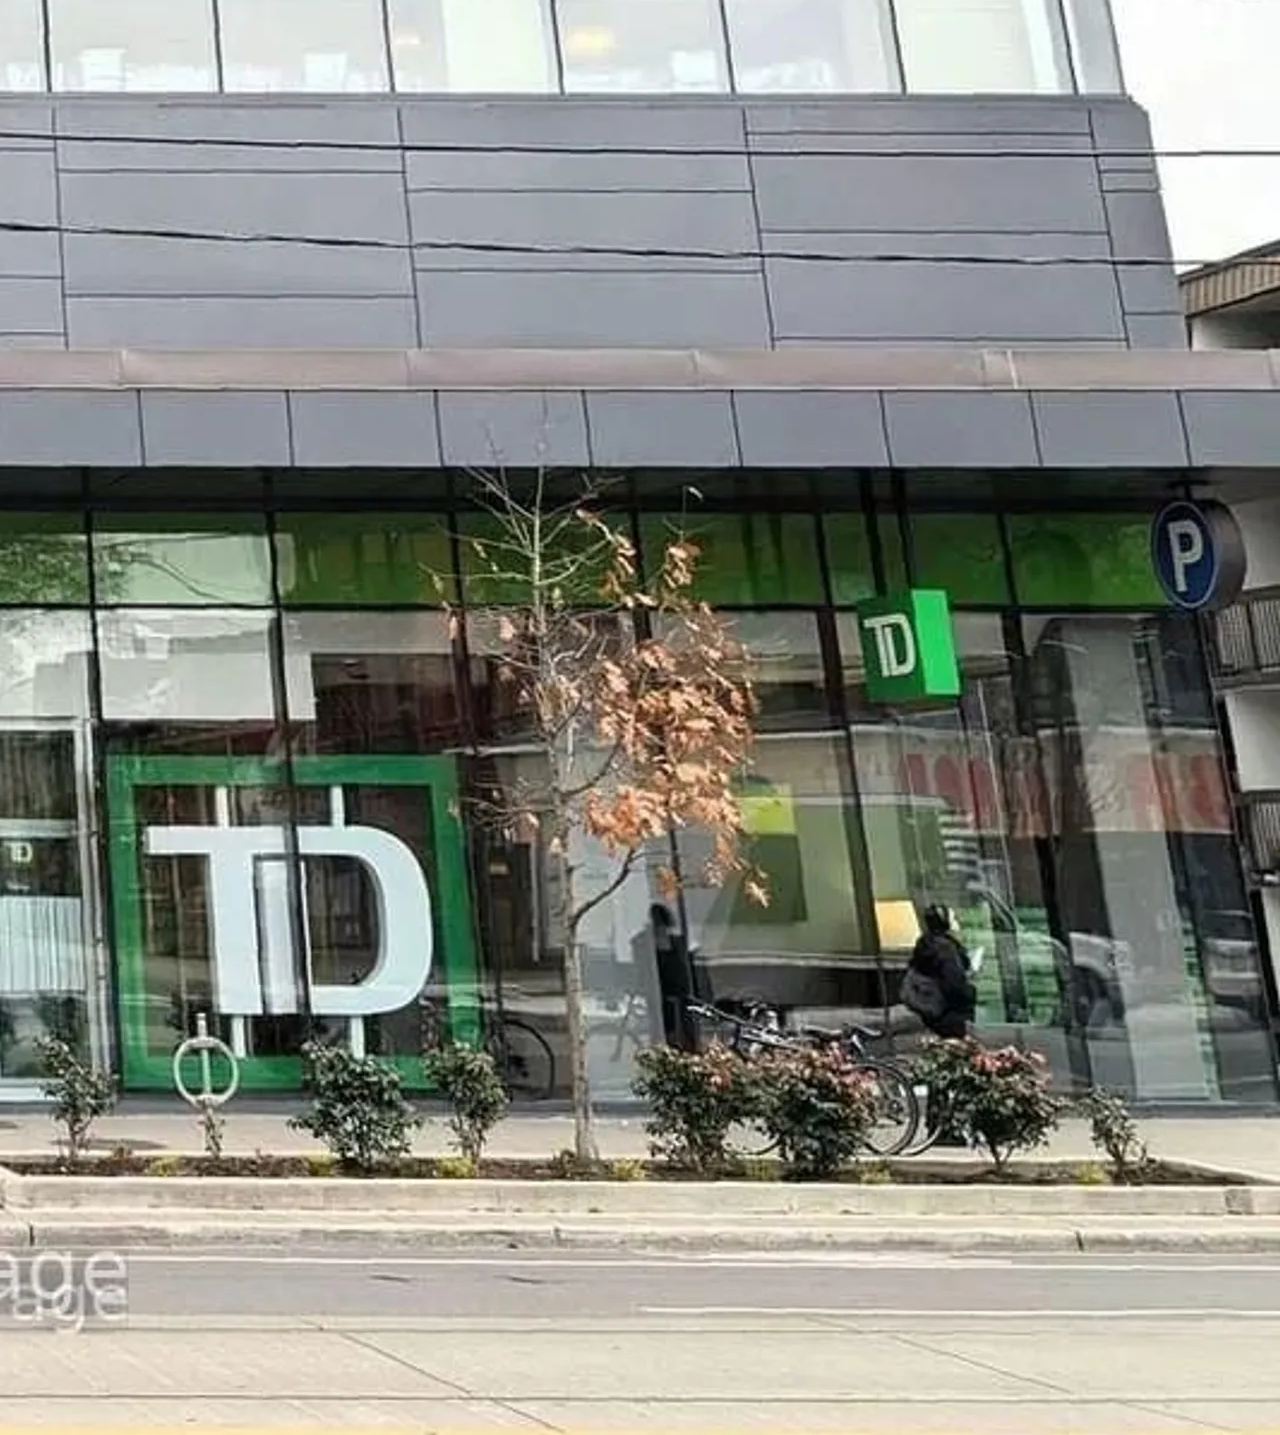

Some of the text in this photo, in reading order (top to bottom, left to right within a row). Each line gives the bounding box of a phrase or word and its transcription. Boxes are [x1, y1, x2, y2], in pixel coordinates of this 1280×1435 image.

[1169, 520, 1204, 592] P
[863, 613, 916, 678] TD
[143, 823, 433, 1016] TD
